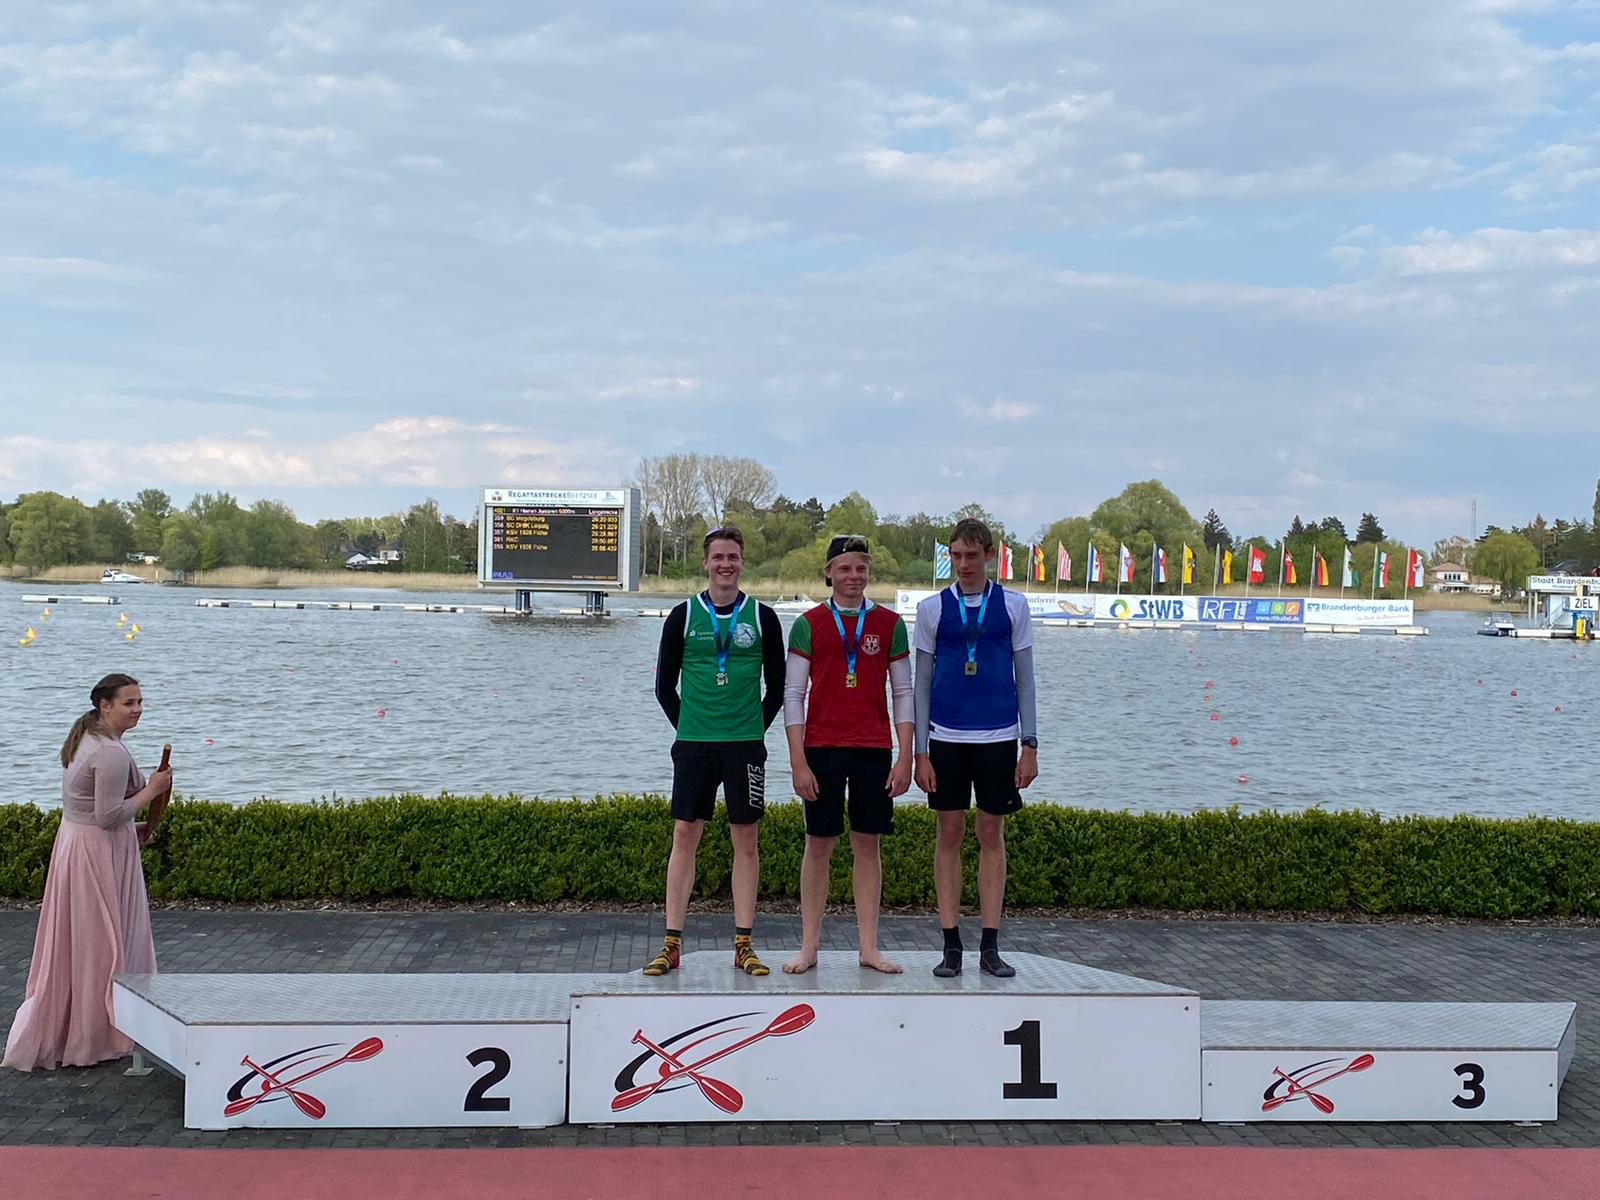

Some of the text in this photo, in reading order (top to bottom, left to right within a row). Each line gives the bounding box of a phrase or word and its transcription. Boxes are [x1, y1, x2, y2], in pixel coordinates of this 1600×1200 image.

[1532, 576, 1554, 584] Stadt
[1132, 599, 1184, 619] StWB
[1321, 603, 1410, 613] Brandenburger Bank
[1575, 598, 1593, 609] ZIEL
[747, 763, 764, 809] NIKE
[1002, 1020, 1058, 1099] 1
[464, 1047, 511, 1111] 2
[1452, 1063, 1486, 1109] 3
